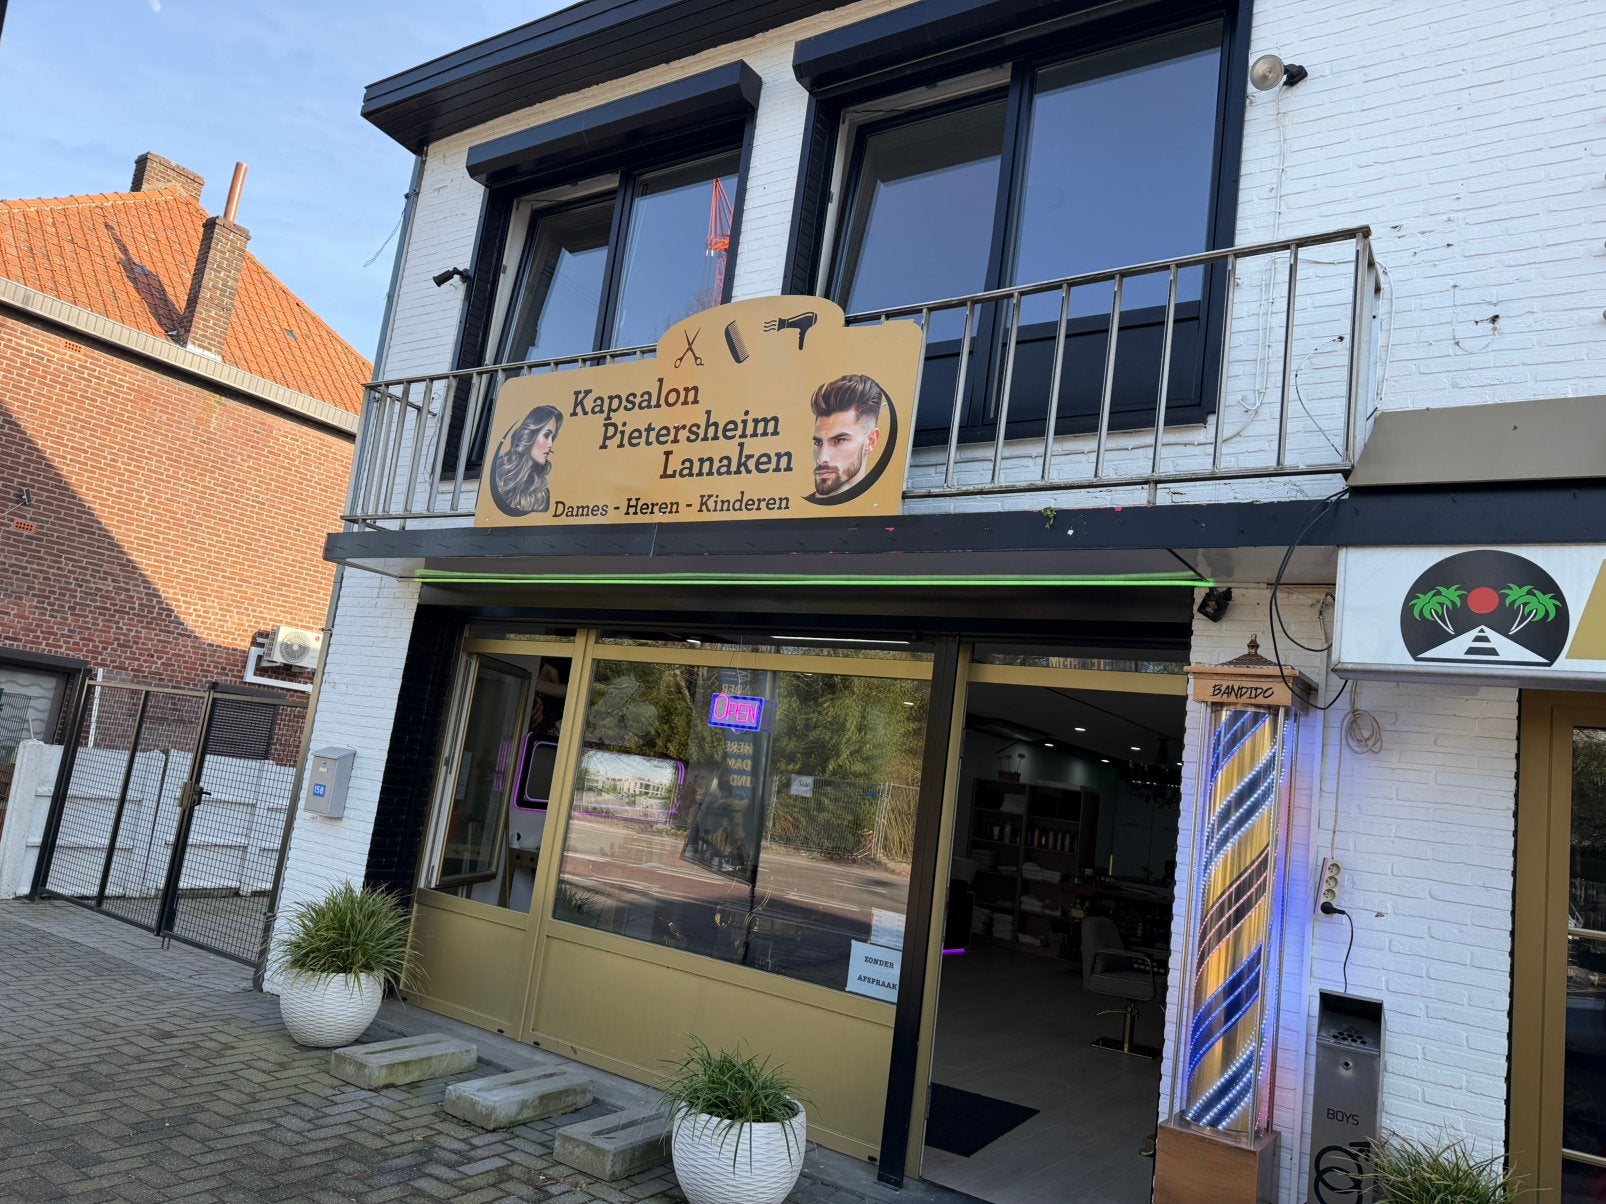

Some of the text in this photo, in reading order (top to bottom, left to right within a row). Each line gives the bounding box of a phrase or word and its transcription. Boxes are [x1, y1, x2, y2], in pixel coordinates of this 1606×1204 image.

[569, 377, 700, 422] Kapsalon
[598, 409, 781, 450] Pietersheim
[659, 441, 794, 480] Lanaken
[552, 500, 609, 518] Dames
[624, 497, 680, 516] Heren
[697, 490, 790, 513] Kinderen
[1210, 683, 1275, 699] BANDIDO
[864, 955, 895, 969] ZONDER
[857, 974, 898, 991] AFSPRAAK
[1326, 1107, 1360, 1126] BOYS
